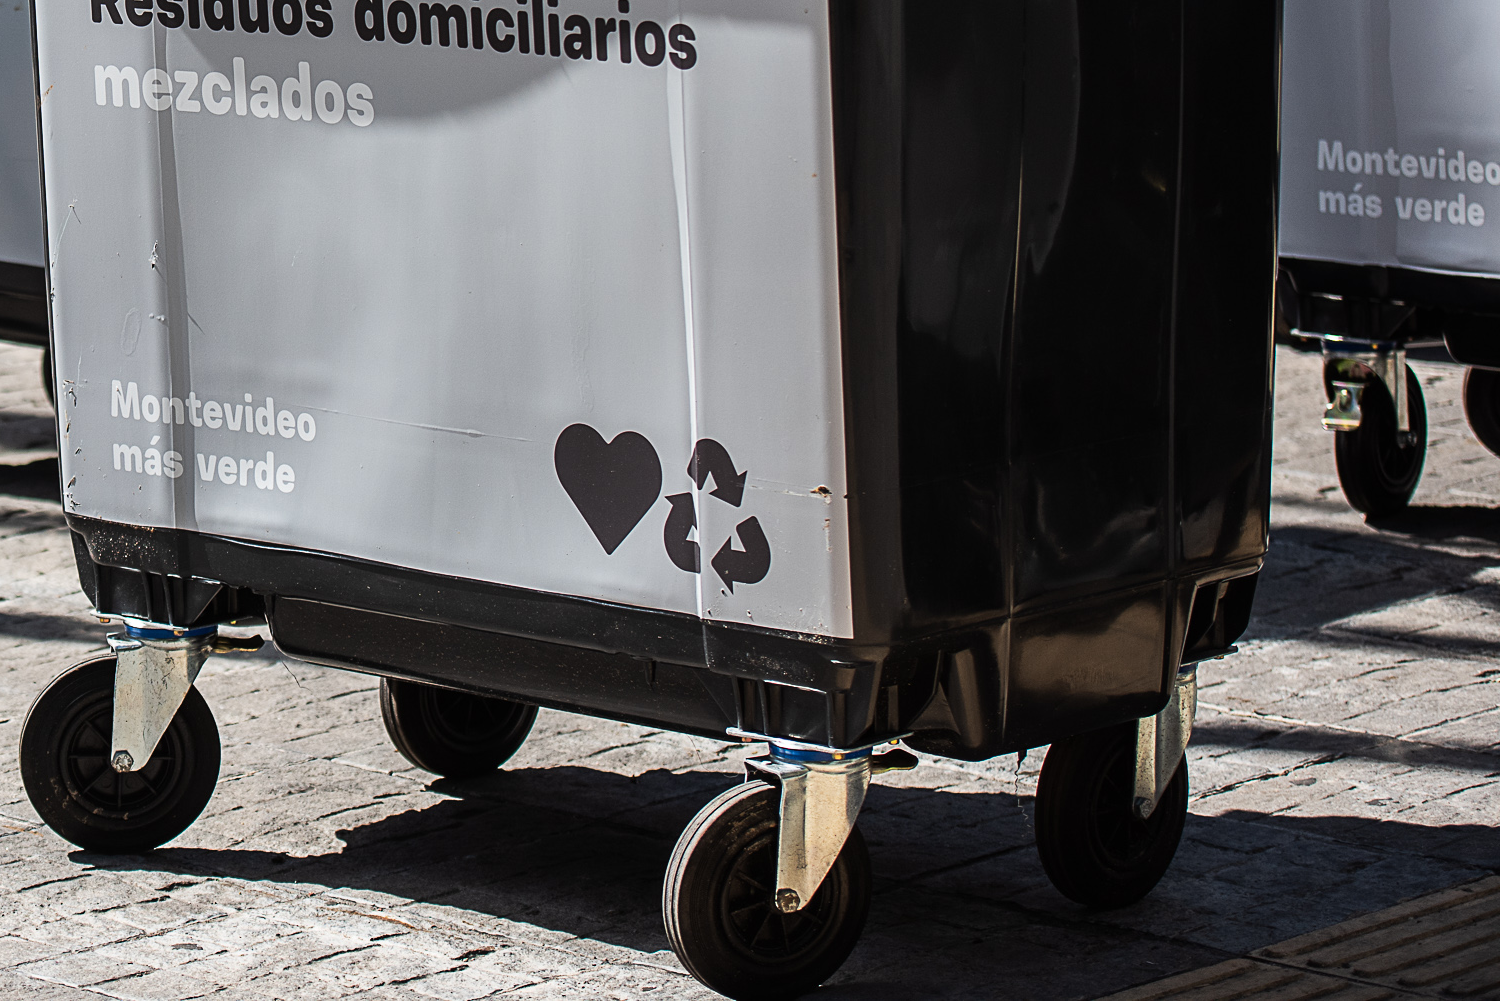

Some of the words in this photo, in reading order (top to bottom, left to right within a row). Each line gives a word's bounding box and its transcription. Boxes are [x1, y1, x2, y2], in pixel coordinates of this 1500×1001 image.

[95, 56, 375, 127] mezclados
[1318, 138, 1500, 186] Montevideo
[1319, 183, 1382, 218] más
[1395, 193, 1485, 227] verde
[111, 379, 317, 442] Montevideo
[113, 435, 184, 479] más
[197, 451, 296, 494] verde
